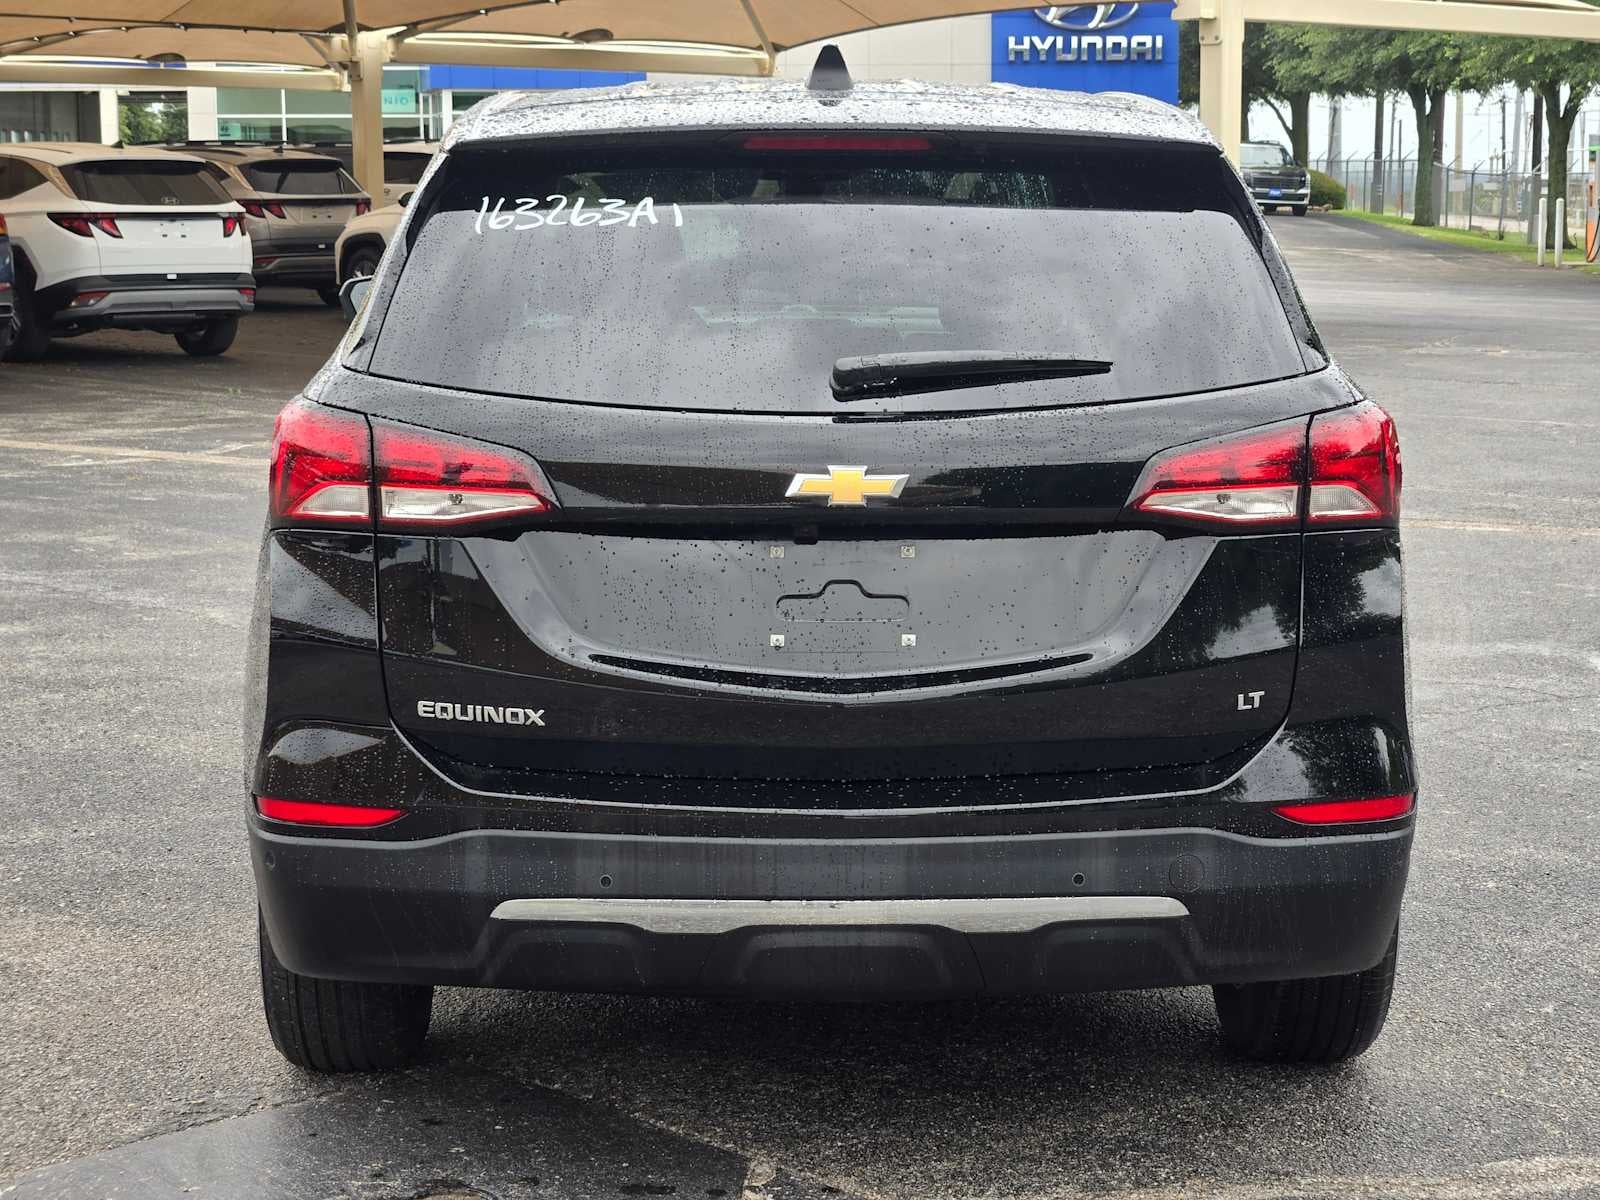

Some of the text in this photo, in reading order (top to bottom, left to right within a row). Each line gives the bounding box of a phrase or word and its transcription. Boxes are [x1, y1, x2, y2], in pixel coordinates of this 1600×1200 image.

[1008, 35, 1163, 62] HYUNDAI
[417, 700, 546, 727] EQUINOX
[1237, 690, 1265, 710] LT
